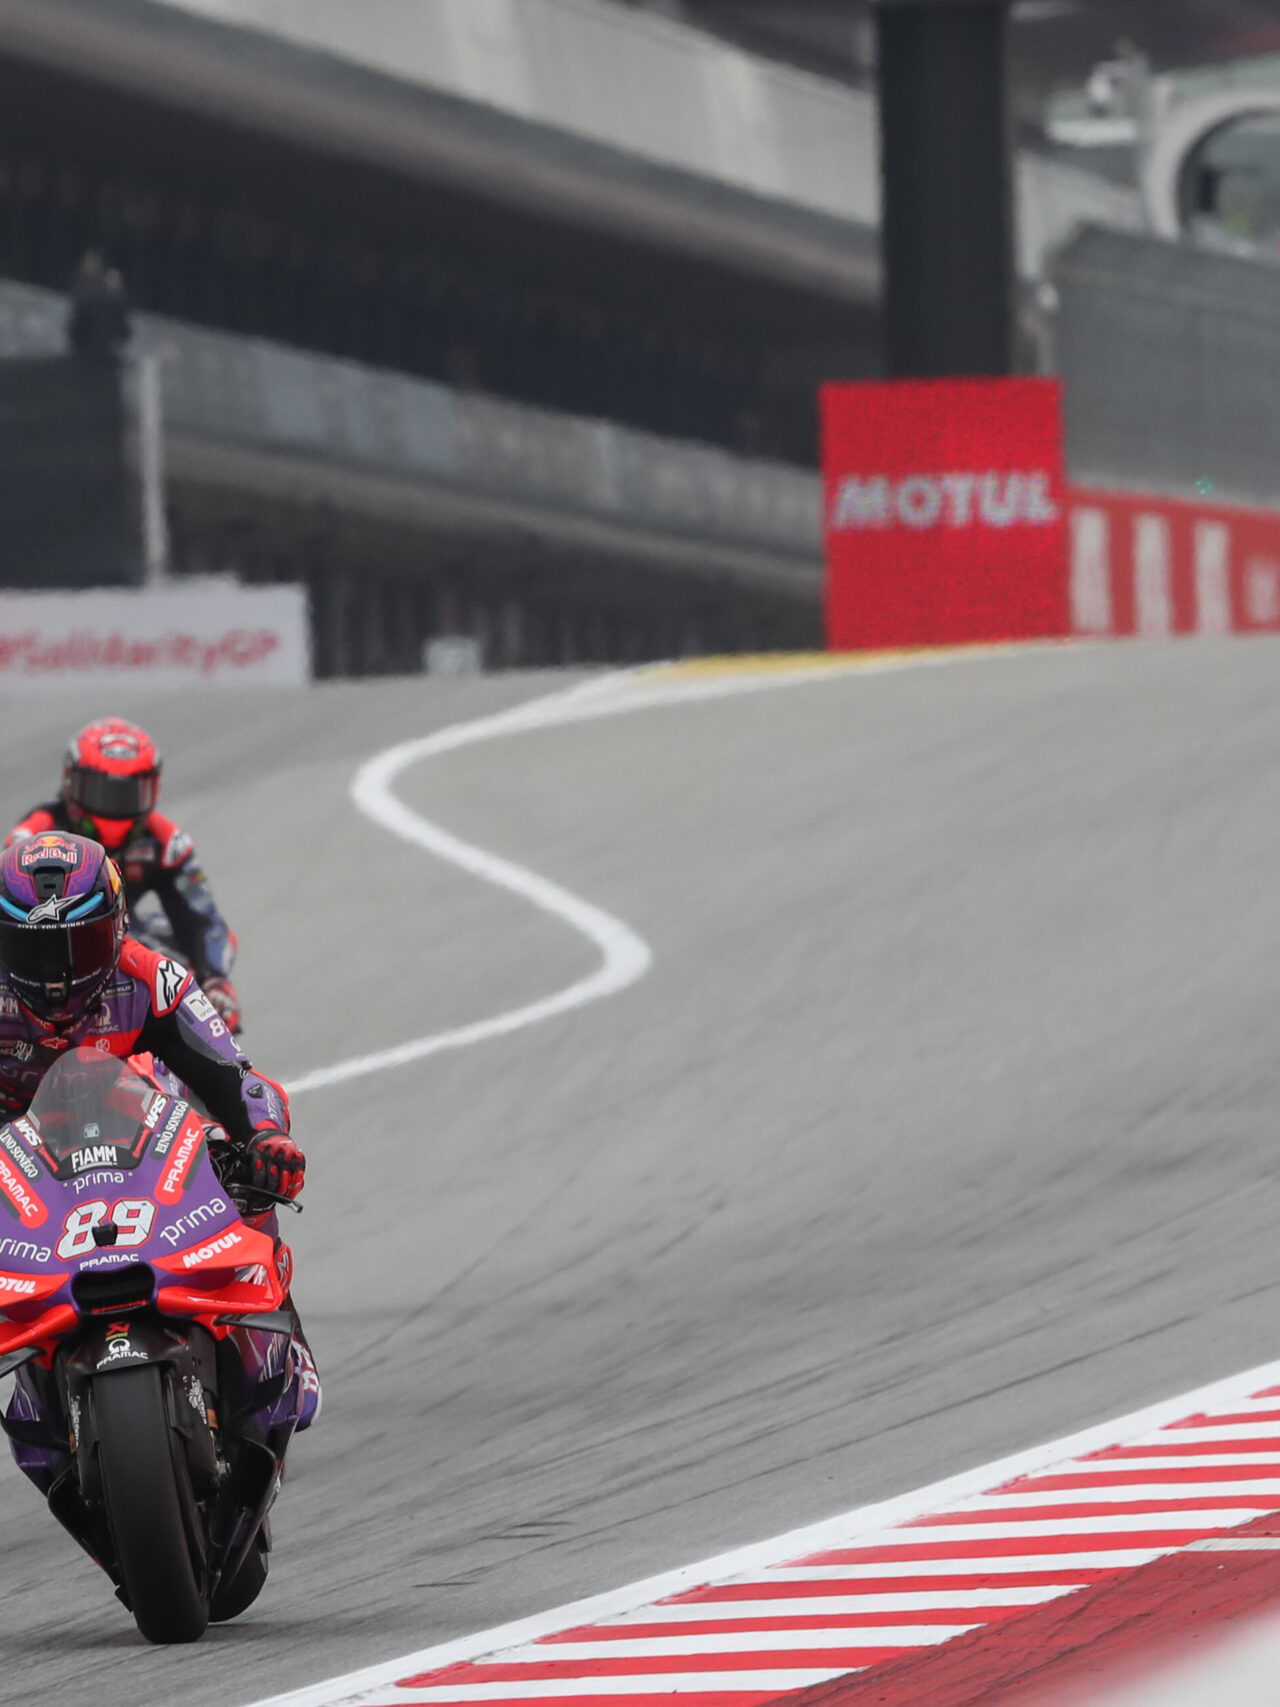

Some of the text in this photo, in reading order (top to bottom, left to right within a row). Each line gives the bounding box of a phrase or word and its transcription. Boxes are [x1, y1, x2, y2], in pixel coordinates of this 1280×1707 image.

[833, 470, 1056, 529] MOTUL
[22, 847, 77, 866] Red Bull
[144, 1094, 167, 1128] WRS
[15, 1119, 43, 1146] WRS
[71, 1146, 118, 1171] FIAMM
[163, 1128, 200, 1193] PRAMAC
[73, 1172, 124, 1195] prima
[56, 1199, 157, 1260] 89
[160, 1197, 227, 1247] prima
[80, 1253, 139, 1271] PRAMAC
[182, 1232, 242, 1268] MOTUL
[96, 1350, 149, 1370] PRAMAC
